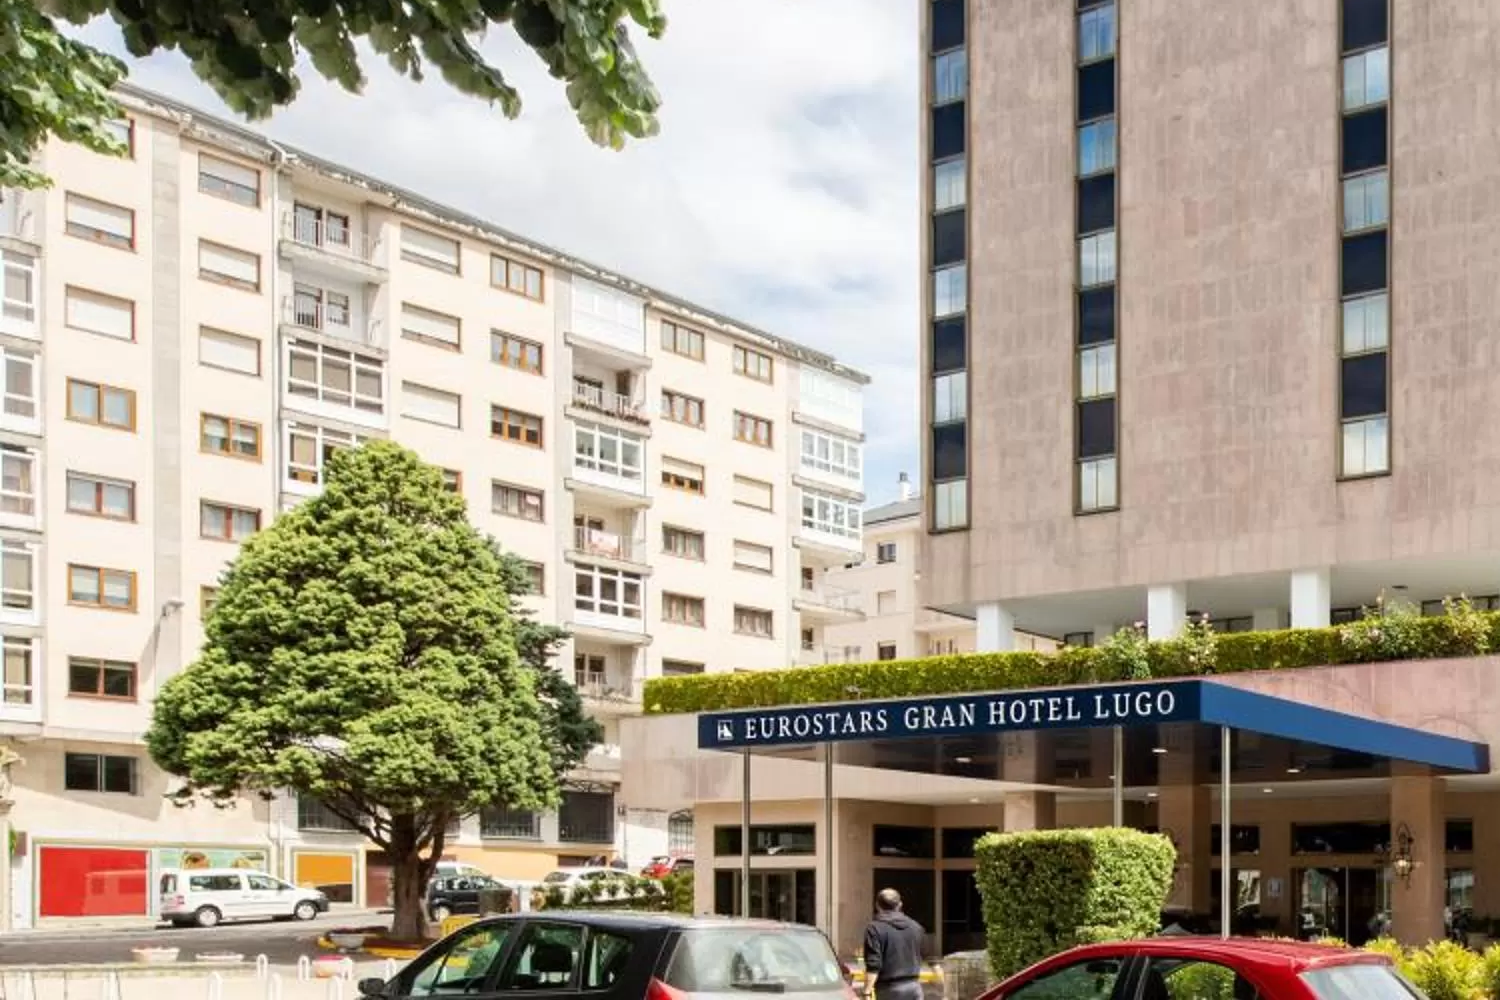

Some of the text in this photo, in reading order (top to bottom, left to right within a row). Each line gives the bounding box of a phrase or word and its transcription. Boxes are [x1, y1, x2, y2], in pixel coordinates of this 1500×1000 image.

[745, 690, 1175, 739] EUROSTARS GRAN HOTEL LUGO
